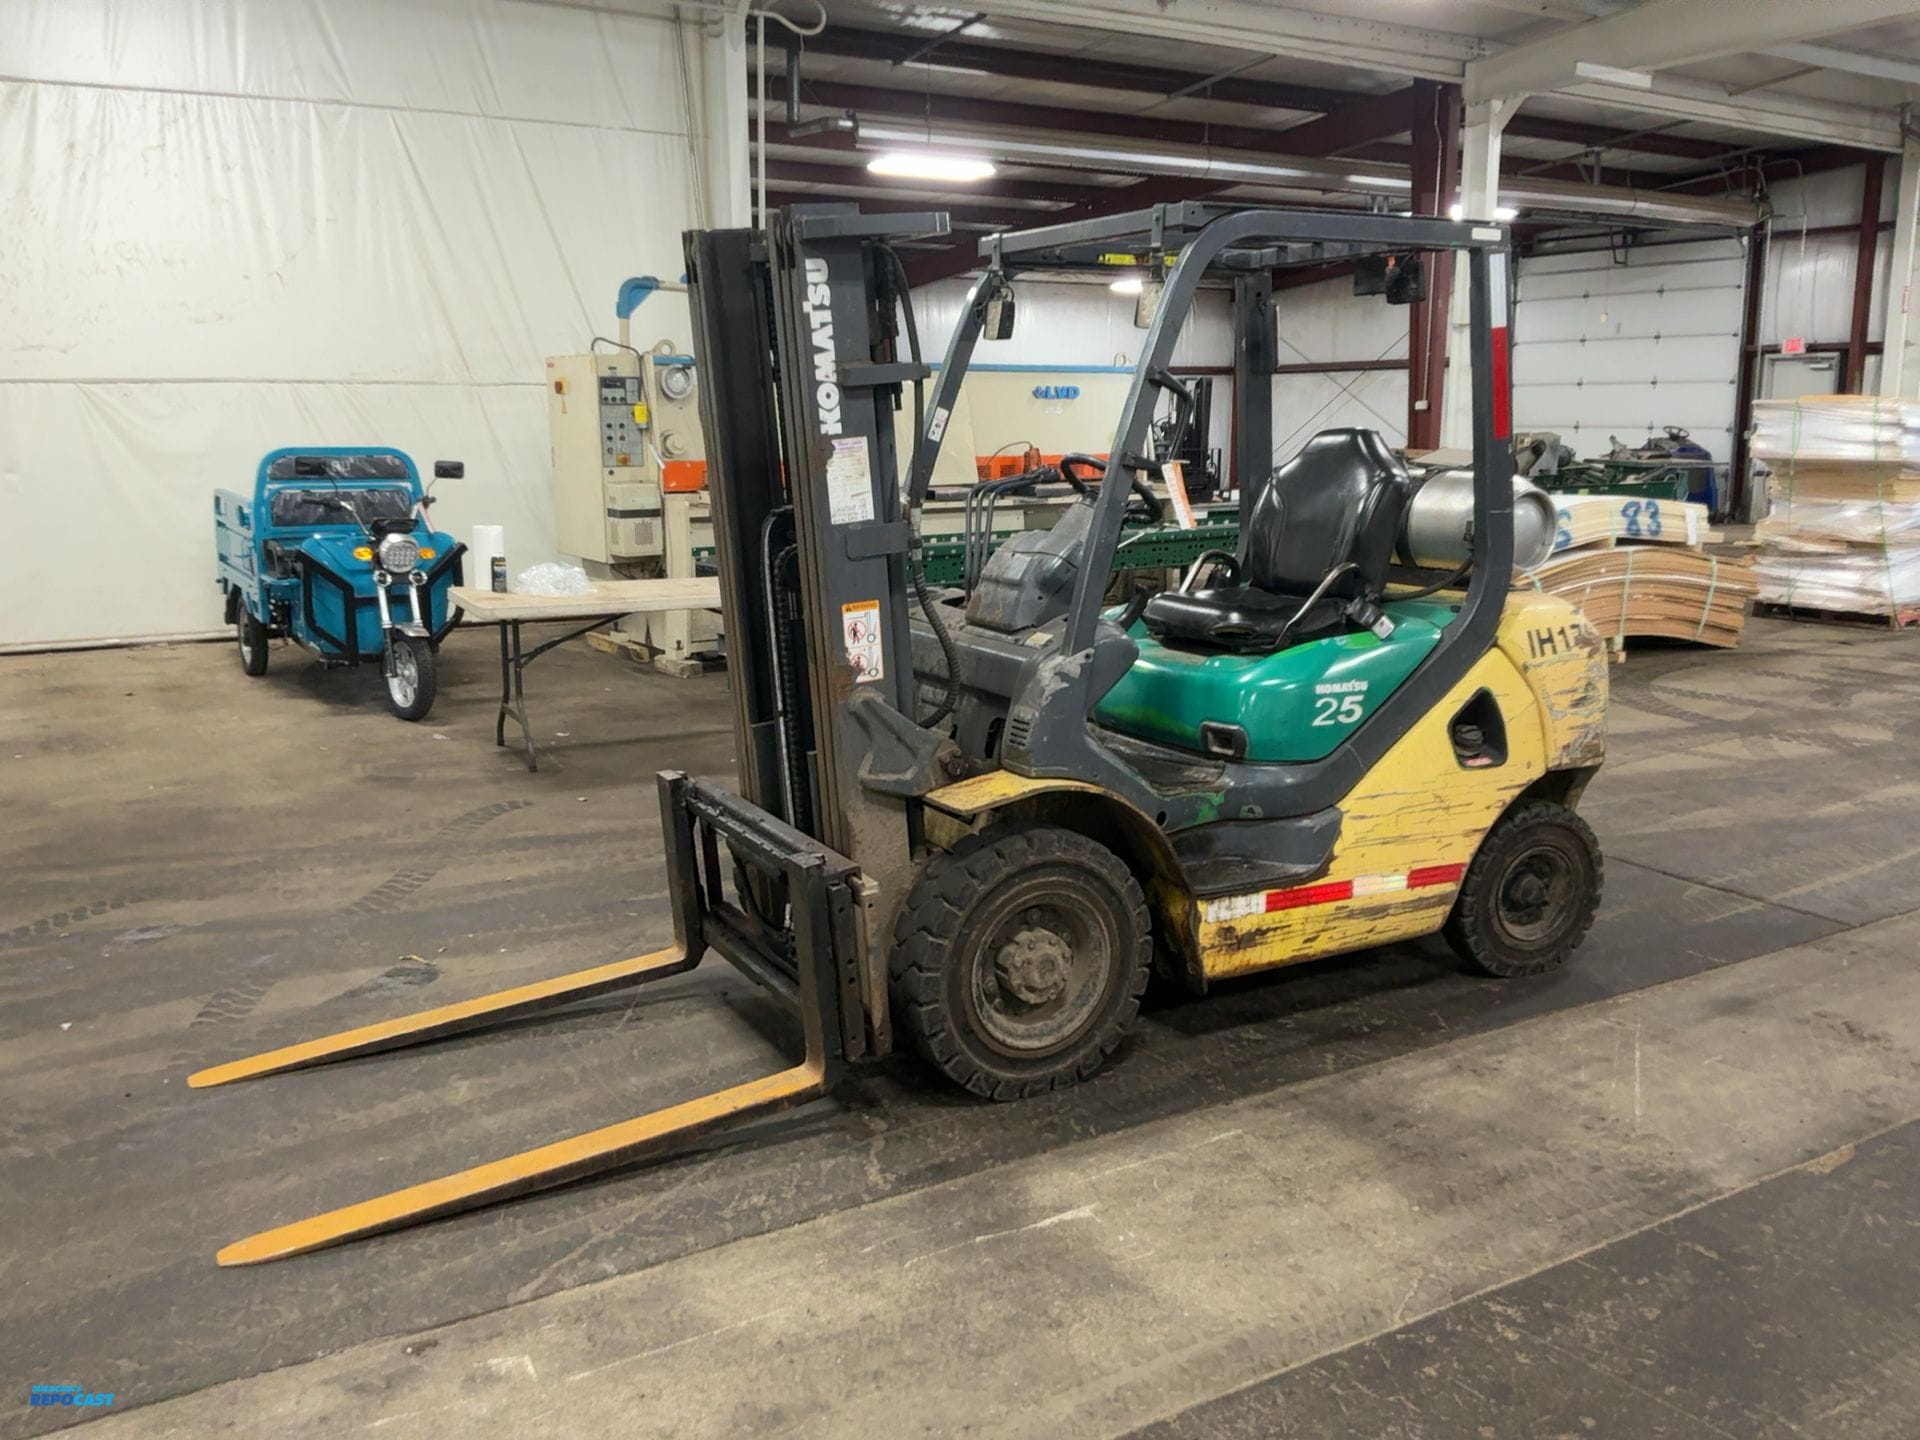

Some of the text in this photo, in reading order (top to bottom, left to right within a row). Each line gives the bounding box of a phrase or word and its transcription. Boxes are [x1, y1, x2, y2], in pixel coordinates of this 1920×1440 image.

[802, 257, 843, 435] KOMATSU
[1315, 679, 1369, 695] KOMATSU
[1311, 694, 1364, 727] 25
